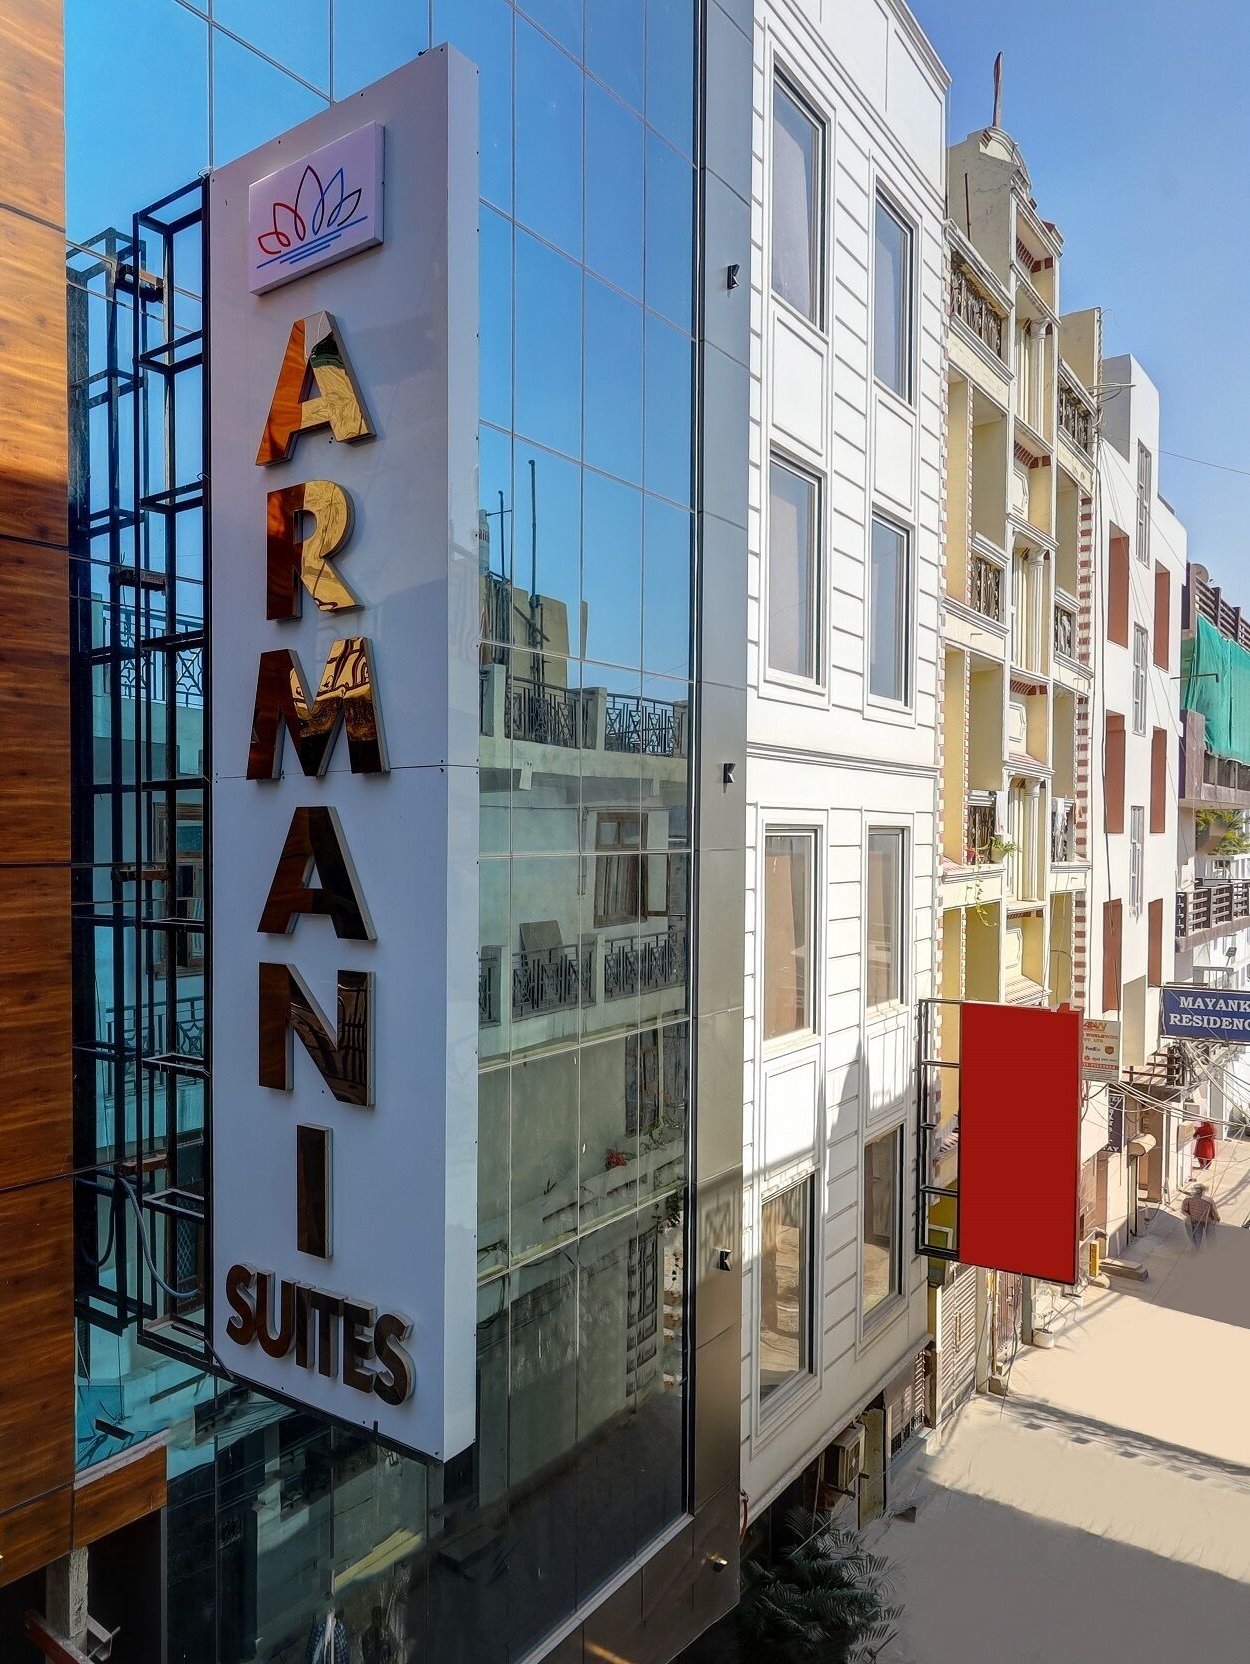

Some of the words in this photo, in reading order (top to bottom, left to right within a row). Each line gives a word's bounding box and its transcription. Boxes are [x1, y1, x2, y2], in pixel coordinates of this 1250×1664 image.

[245, 310, 391, 1260] ARMANI
[1179, 996, 1250, 1013] MAYANK
[224, 1261, 417, 1407] SUITES
